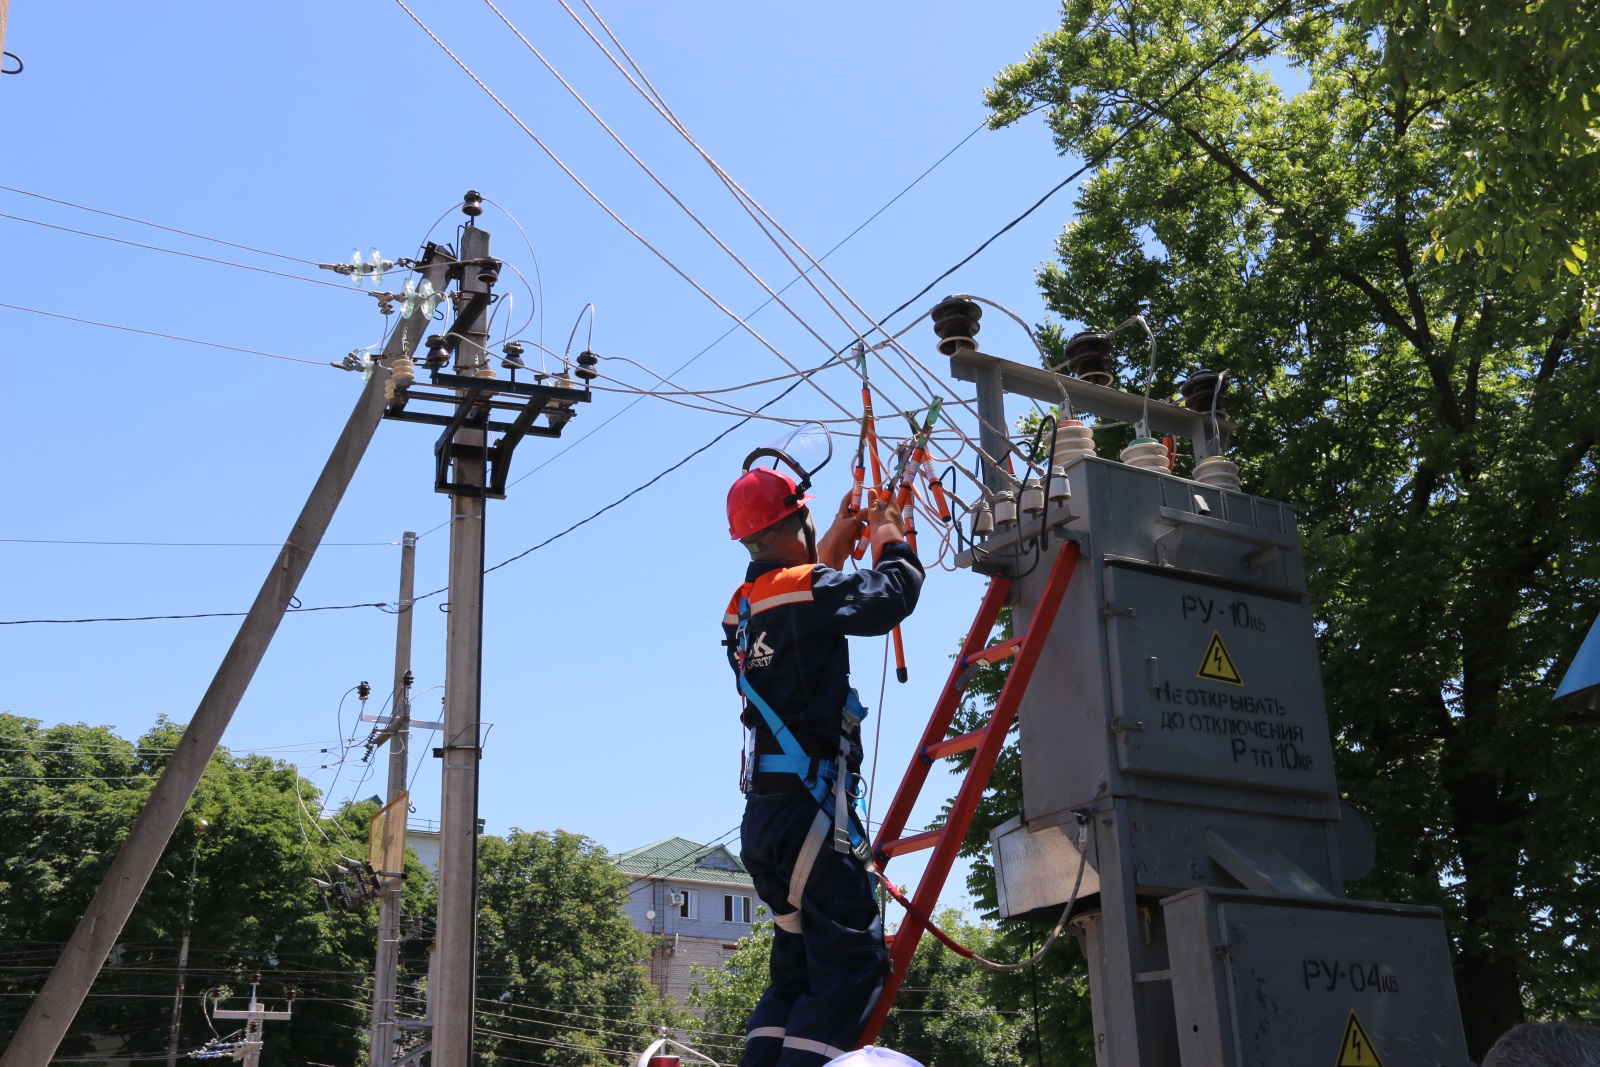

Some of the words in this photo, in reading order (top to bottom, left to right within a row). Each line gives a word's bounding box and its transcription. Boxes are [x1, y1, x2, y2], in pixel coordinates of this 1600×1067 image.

[1186, 689, 1286, 716] ОТКРЫВАТЬ
[1161, 711, 1185, 731] ДО
[1189, 714, 1304, 742] ОТКЛЮЧЕНИЯ
